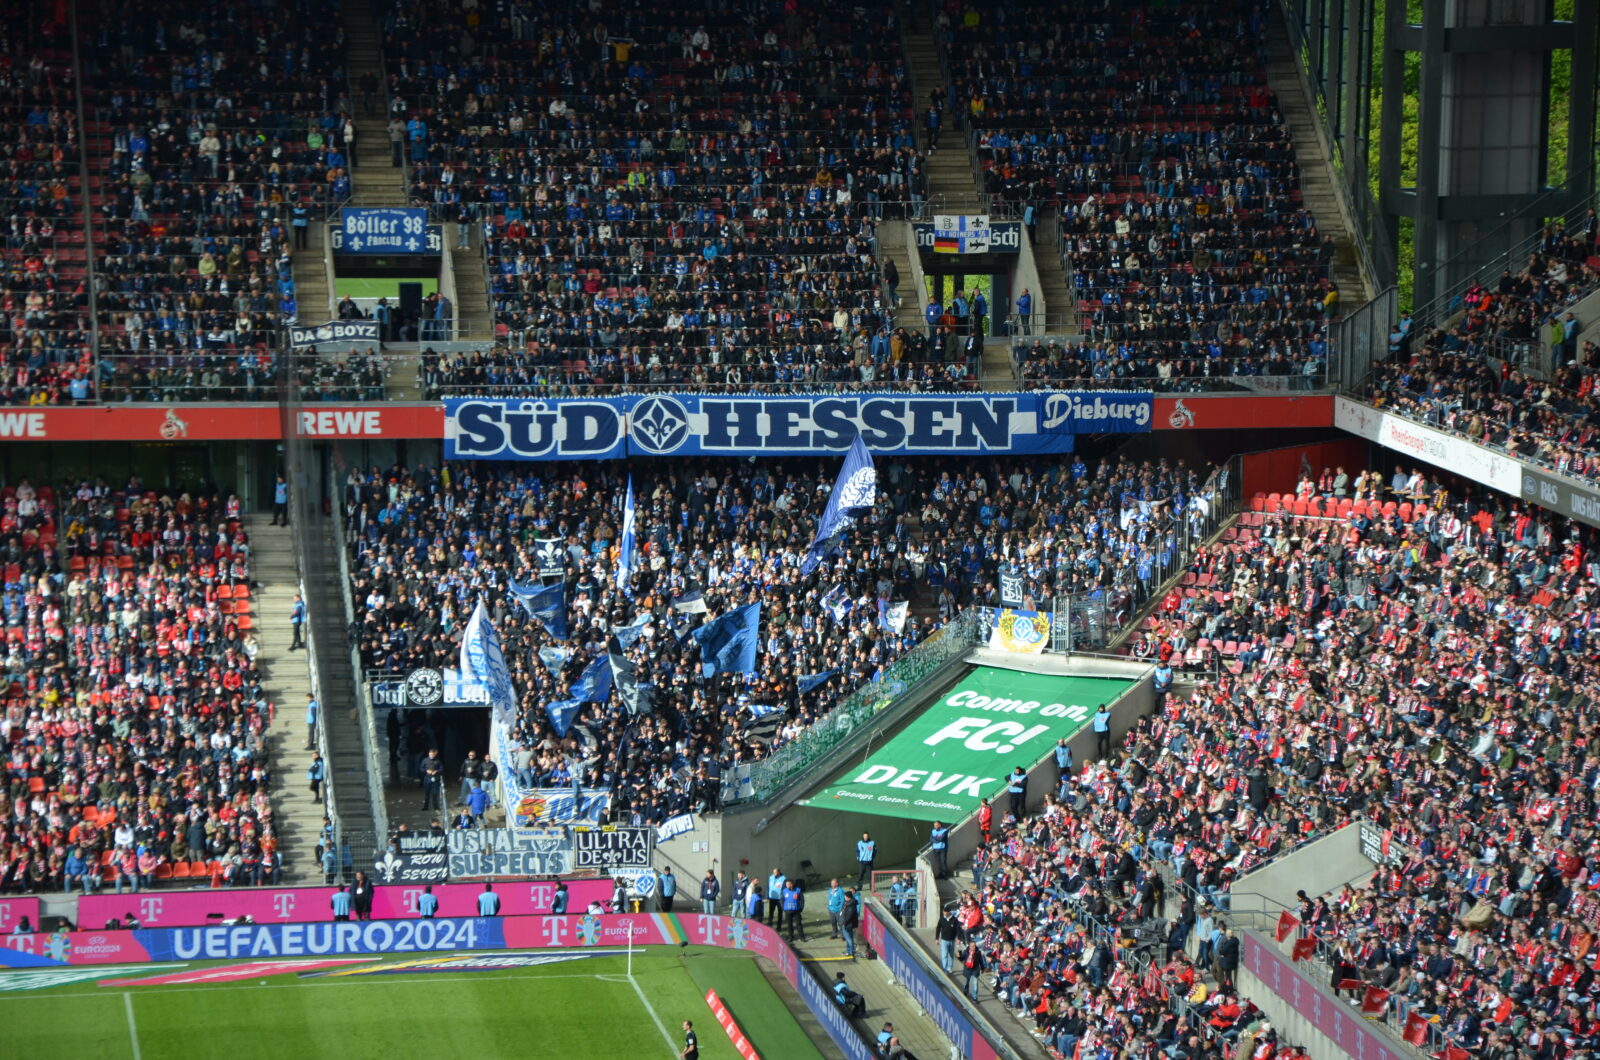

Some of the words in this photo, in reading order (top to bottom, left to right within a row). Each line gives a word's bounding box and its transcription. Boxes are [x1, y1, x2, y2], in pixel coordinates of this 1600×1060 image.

[346, 215, 398, 234] Böller
[403, 216, 422, 234] 98
[293, 330, 316, 342] DA
[334, 325, 376, 337] BOYZ
[1042, 393, 1150, 428] Dieburg
[297, 411, 382, 435] REWE
[455, 400, 621, 456] SÜD
[699, 398, 1017, 451] HESSEN
[1540, 481, 1558, 505] R&S
[1571, 493, 1586, 516] UNS
[945, 690, 1041, 714] Come
[1039, 702, 1089, 722] on,
[922, 716, 1051, 754] FC!
[853, 765, 999, 798] DEVK
[836, 789, 874, 801] Gesagt.
[877, 795, 910, 806] Getan.
[913, 799, 963, 812] Geholfen.
[448, 830, 528, 854] USUAL
[577, 831, 647, 850] ULTRA
[410, 853, 445, 865] ROW
[450, 852, 565, 876] SUSPECTS
[579, 850, 603, 865] DE
[623, 849, 647, 864] LIS
[401, 867, 448, 881] SEVEN
[604, 927, 648, 936] EURO024
